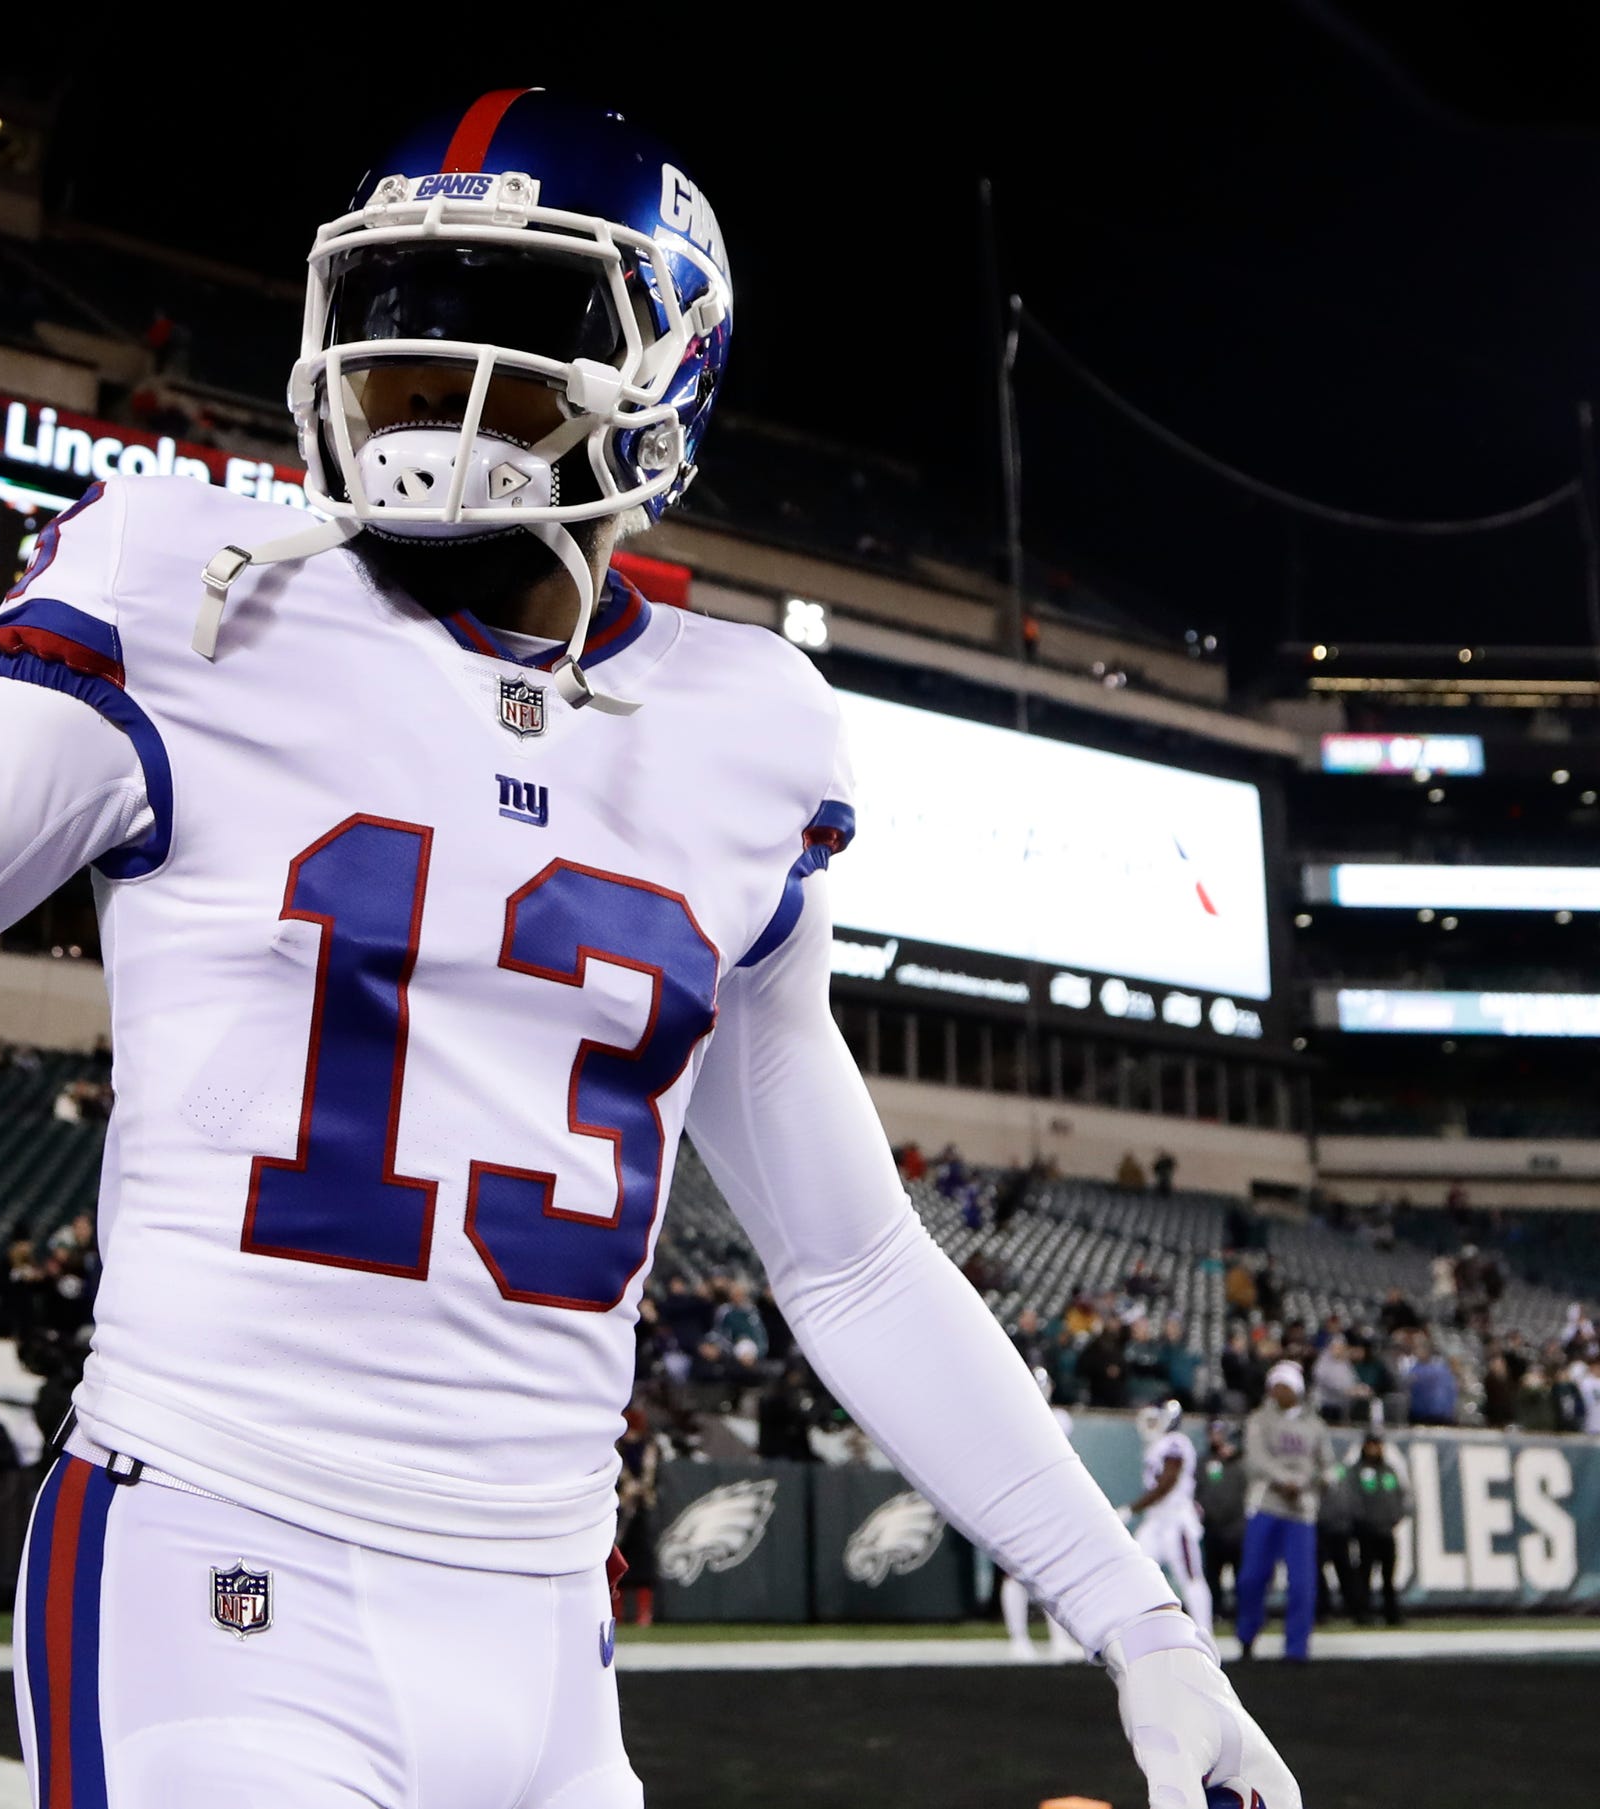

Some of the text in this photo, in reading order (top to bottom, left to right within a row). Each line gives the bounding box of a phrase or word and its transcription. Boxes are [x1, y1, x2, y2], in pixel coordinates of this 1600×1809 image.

[416, 174, 494, 197] GIANTS
[4, 402, 212, 486] Lincoln
[505, 700, 540, 729] NFL
[240, 812, 720, 1312] 13
[219, 1594, 264, 1625] NFL
